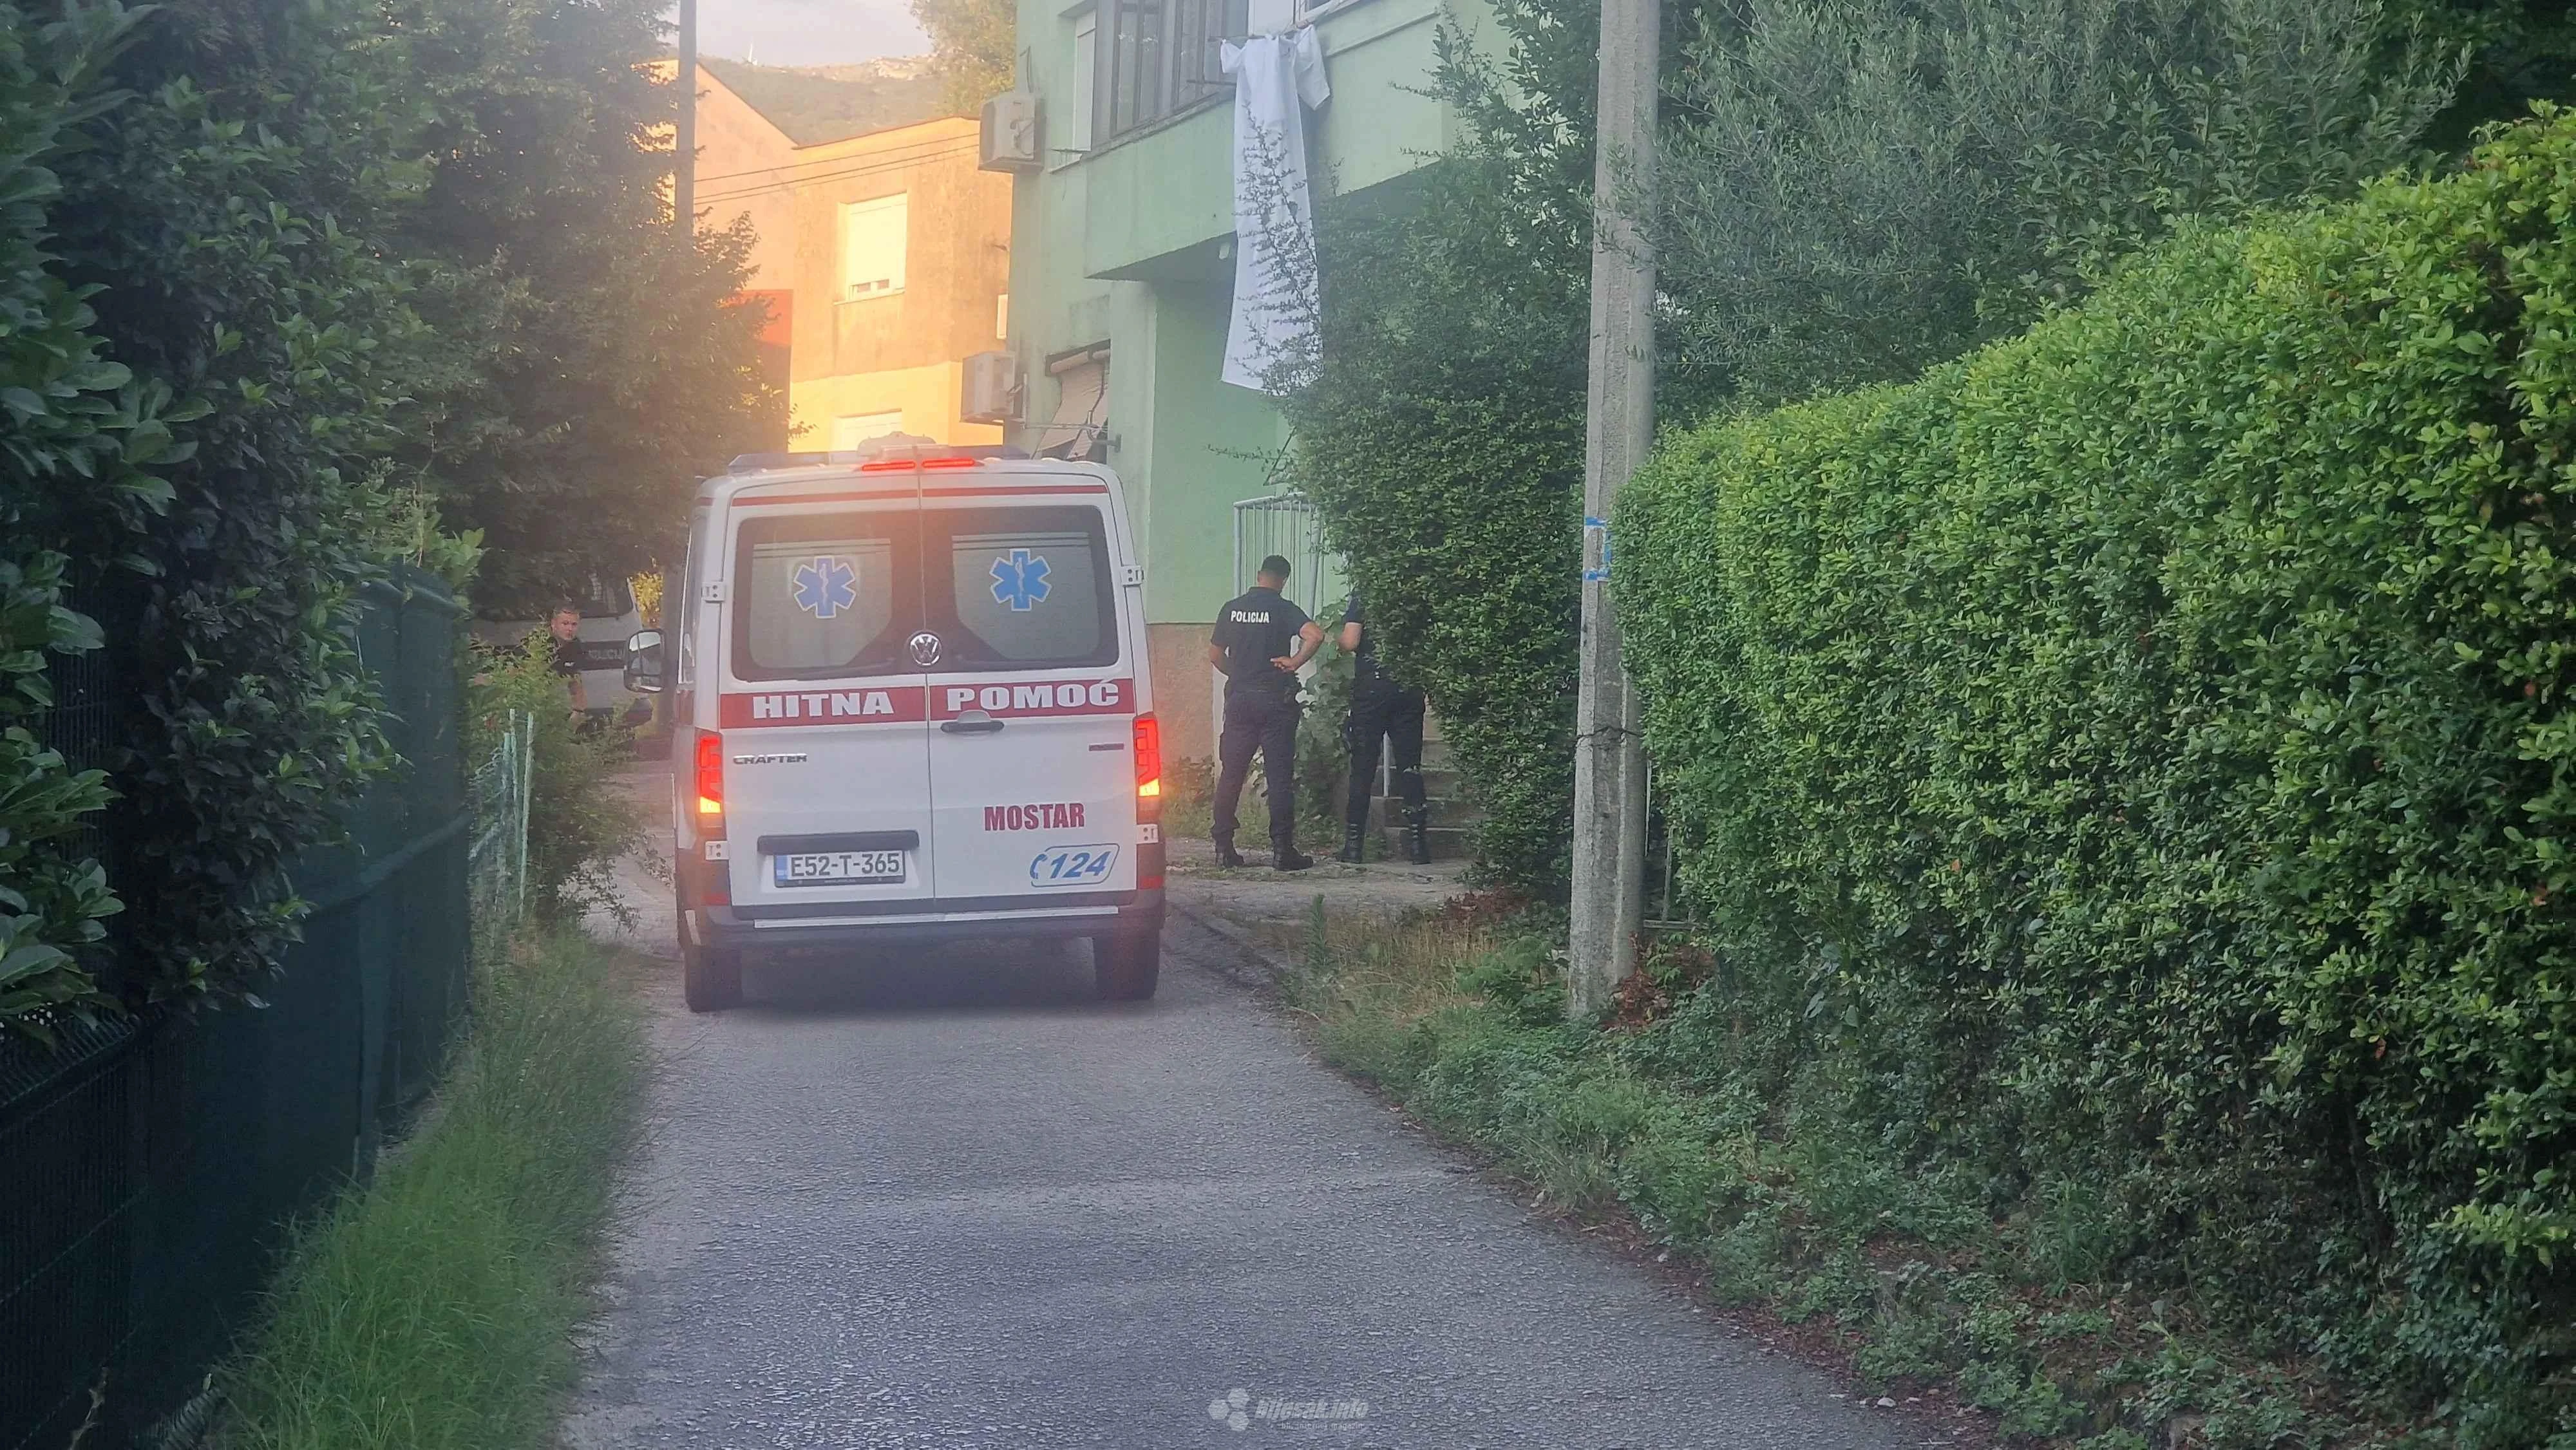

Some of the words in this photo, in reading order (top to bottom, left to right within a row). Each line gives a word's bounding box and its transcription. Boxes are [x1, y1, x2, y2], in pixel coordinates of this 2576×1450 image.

[1231, 610, 1269, 623] POLICIJA
[753, 692, 894, 719] HITNA
[733, 753, 807, 764] CRAFTER
[984, 803, 1084, 831] MOSTAR
[791, 853, 899, 876] E52-T-365
[1050, 851, 1111, 879] 124
